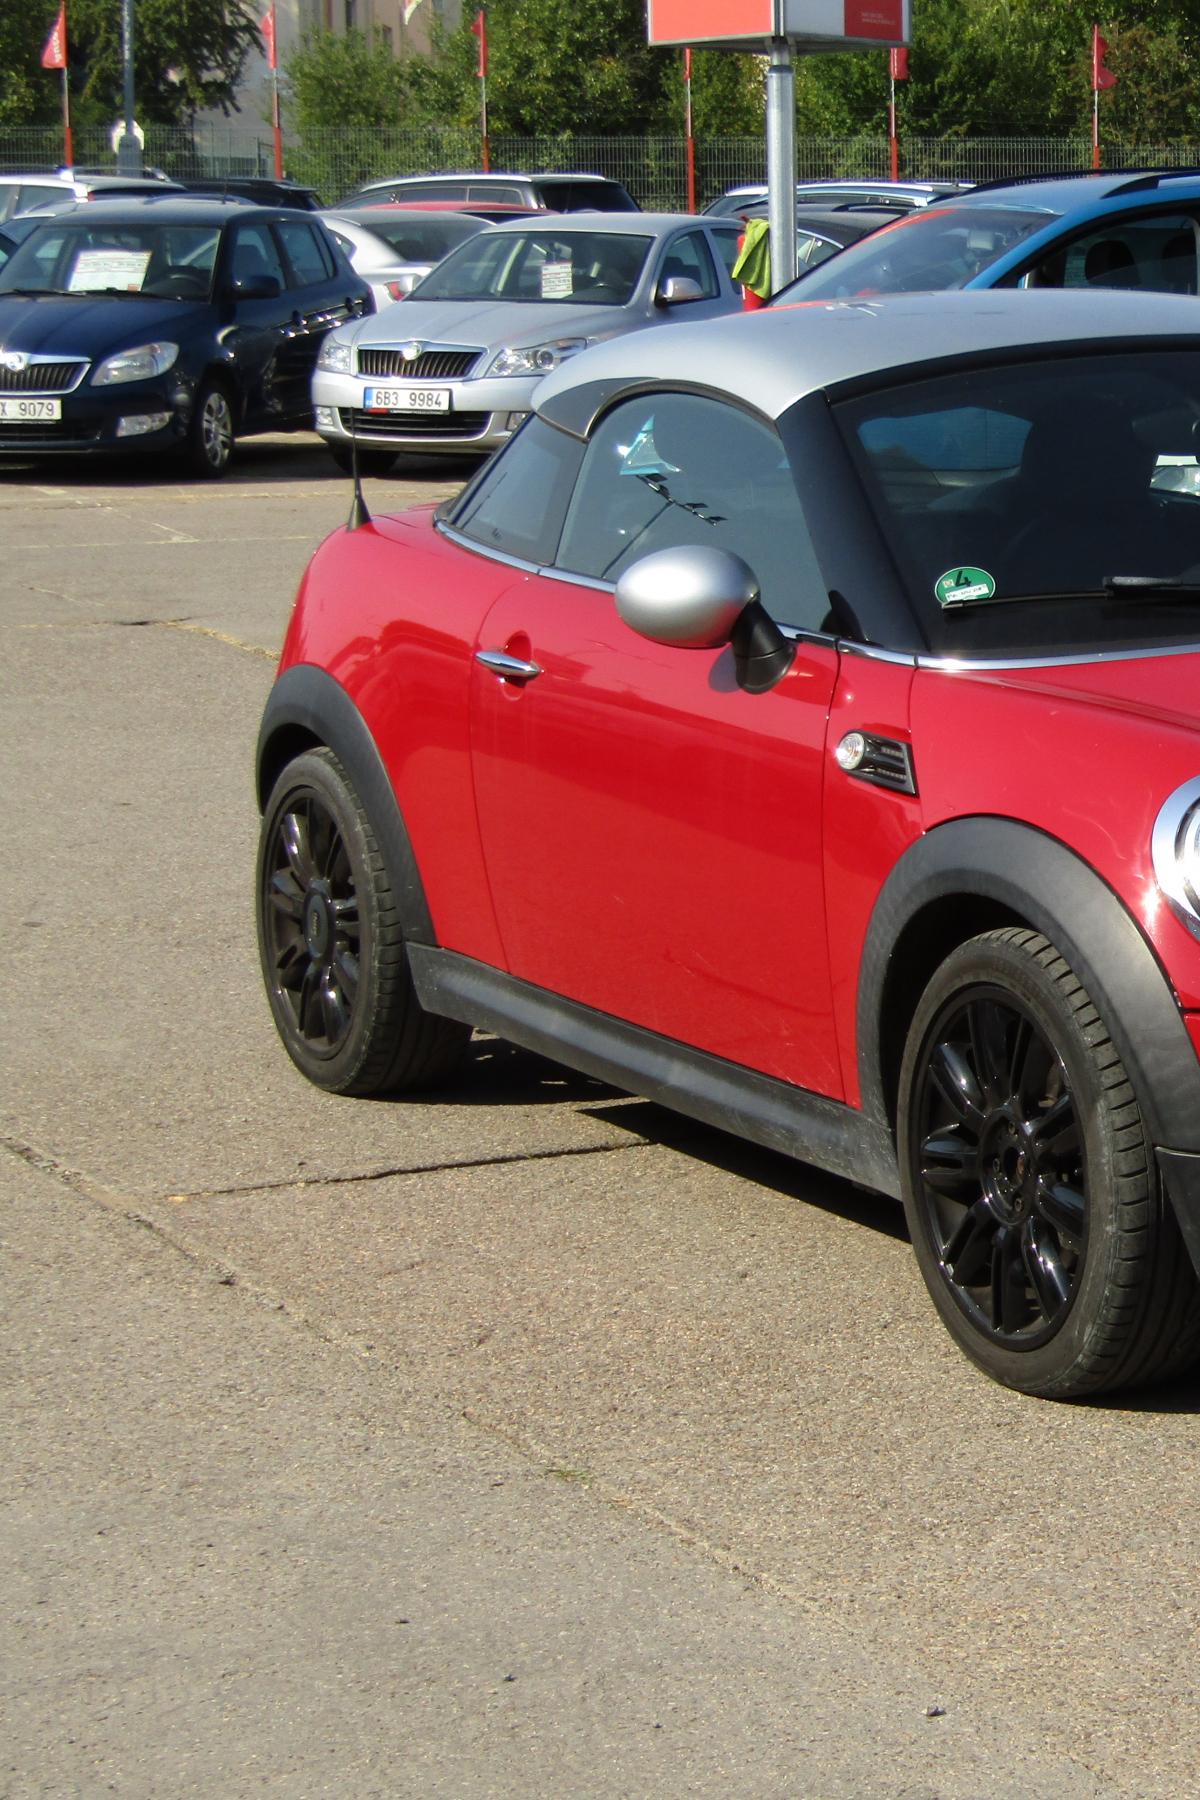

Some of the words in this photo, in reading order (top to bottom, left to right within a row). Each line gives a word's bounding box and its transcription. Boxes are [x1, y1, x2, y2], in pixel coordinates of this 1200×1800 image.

[376, 391, 399, 406] 6B3
[409, 392, 442, 407] 9984
[19, 402, 54, 416] 9079
